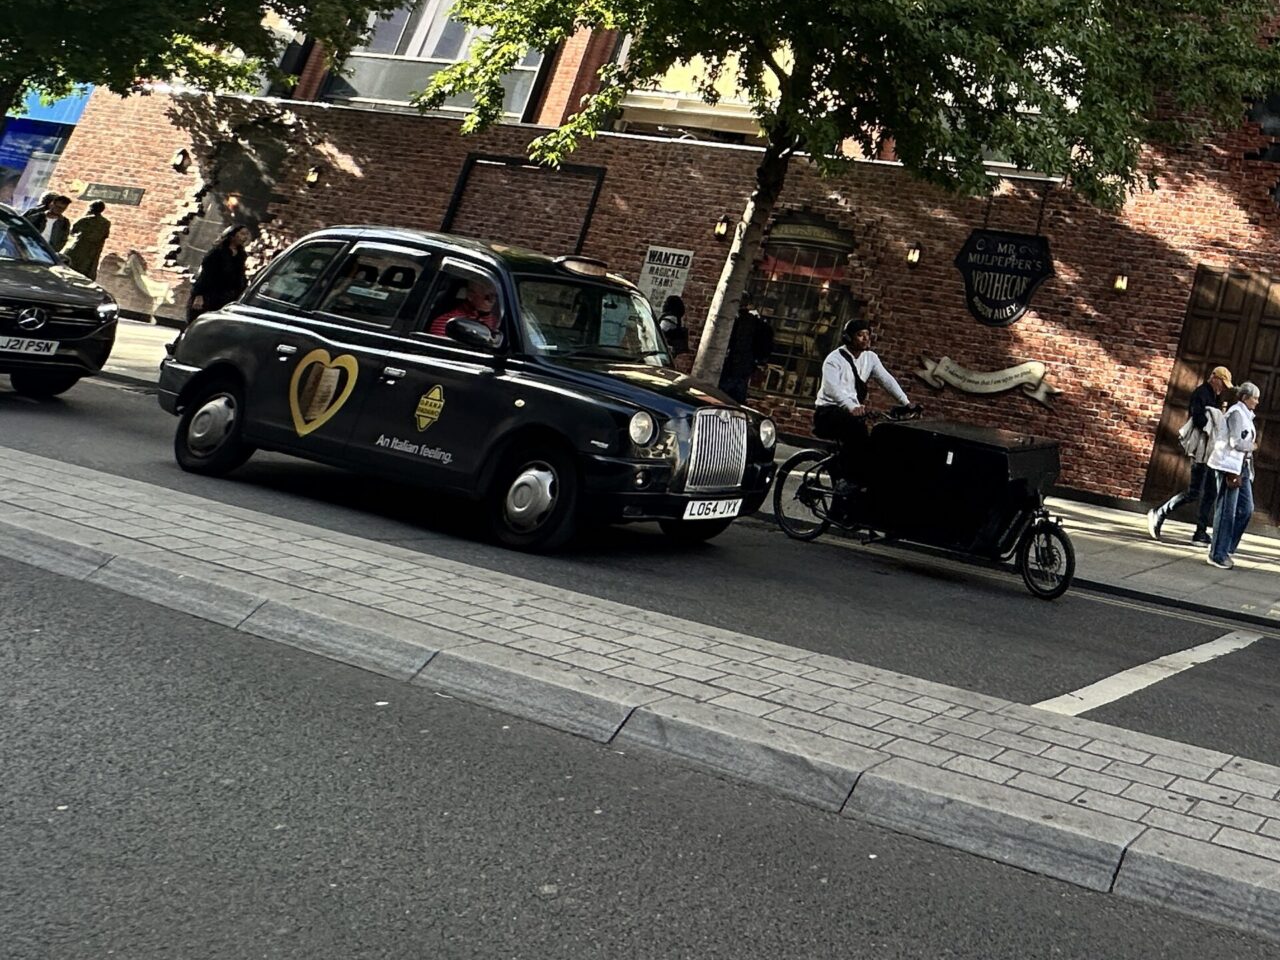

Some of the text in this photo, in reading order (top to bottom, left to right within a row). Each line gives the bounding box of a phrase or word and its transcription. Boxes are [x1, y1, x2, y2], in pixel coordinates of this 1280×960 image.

[648, 250, 690, 267] WANTED
[967, 252, 1042, 271] MULPEPPER'S
[648, 266, 680, 279] MAGICAL
[25, 340, 53, 352] PSN
[375, 434, 453, 464] An Italian feeling.
[689, 500, 739, 516] LO64 JYX
